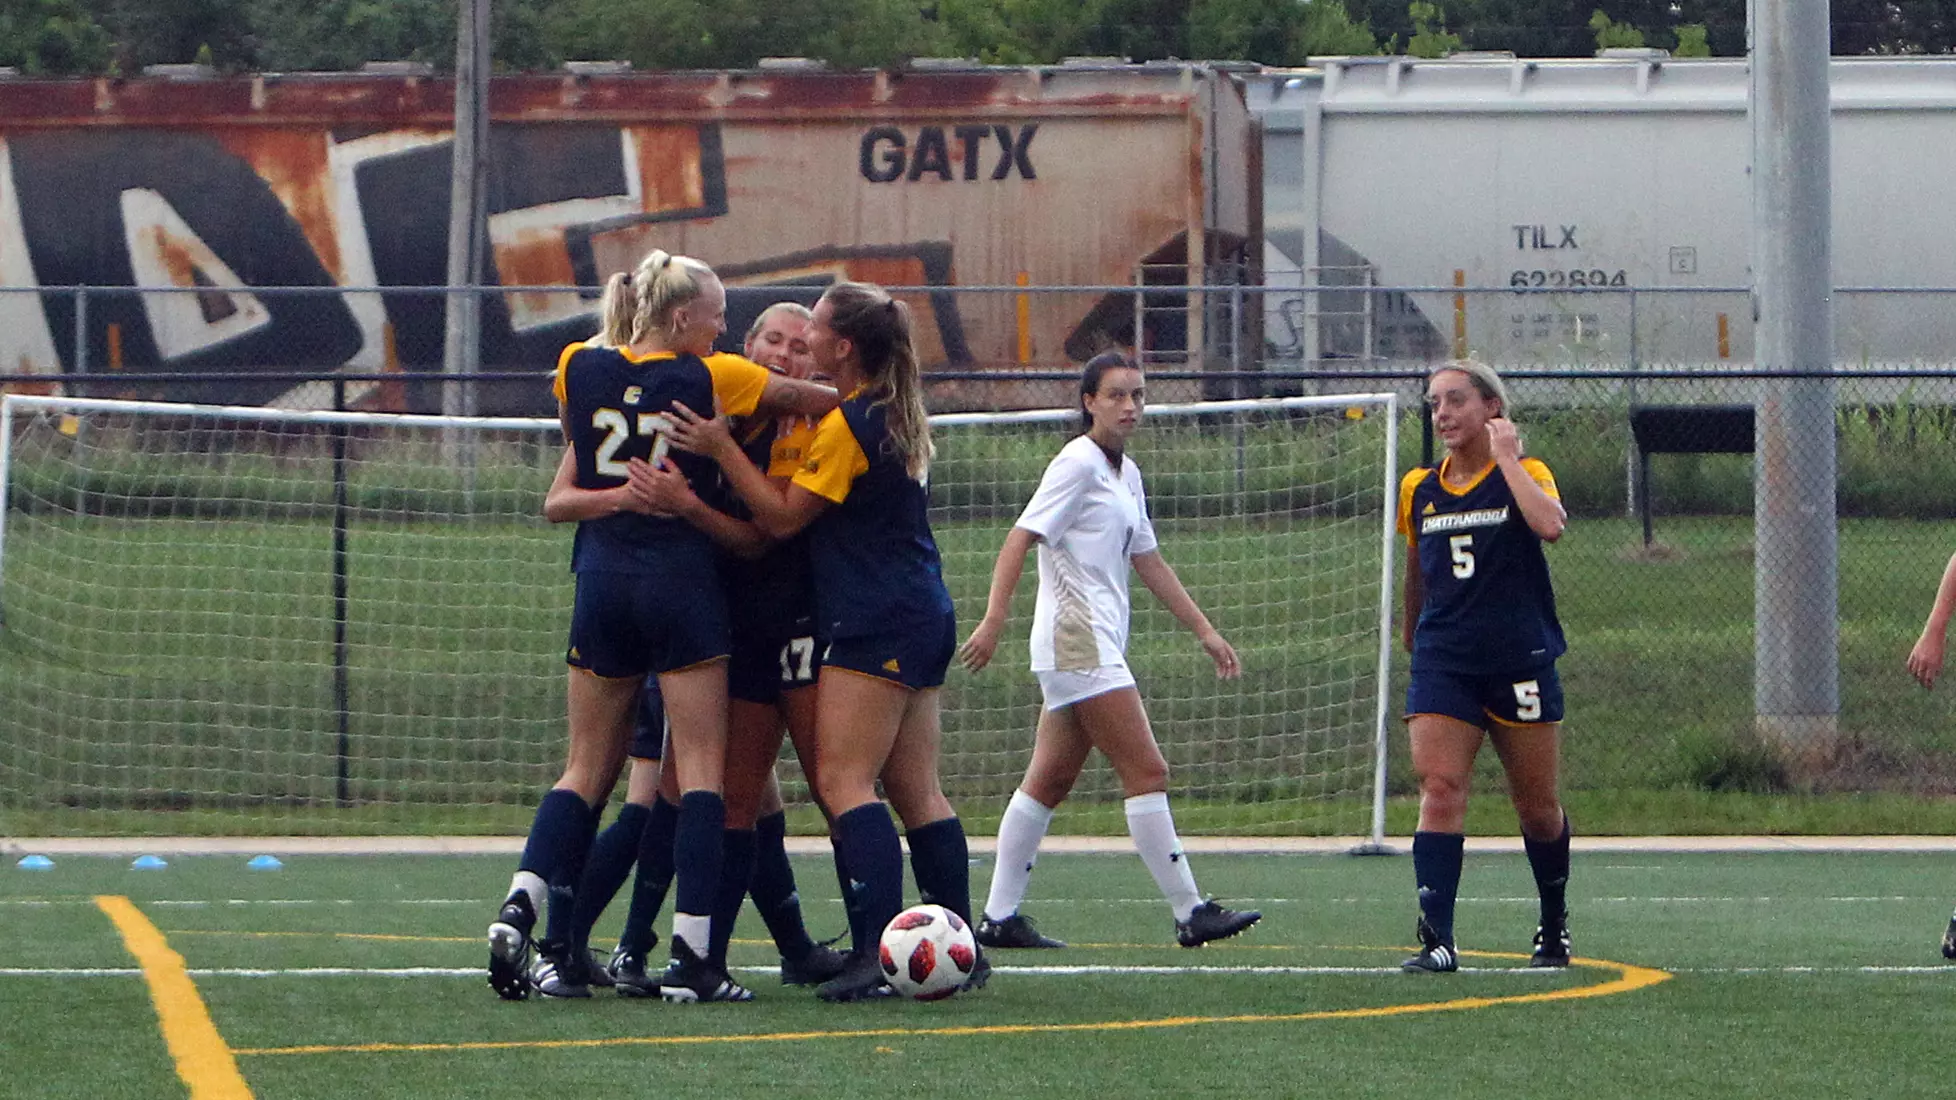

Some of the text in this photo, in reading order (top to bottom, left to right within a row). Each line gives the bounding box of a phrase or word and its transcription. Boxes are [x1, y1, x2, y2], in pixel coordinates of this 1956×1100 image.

[860, 124, 1038, 182] GATX
[1513, 225, 1579, 250] TILX
[1510, 269, 1627, 293] 622894
[592, 407, 673, 476] 27
[1421, 504, 1509, 535] CHATTANOOGA
[1449, 534, 1475, 580] 5
[1512, 680, 1541, 720] 5
